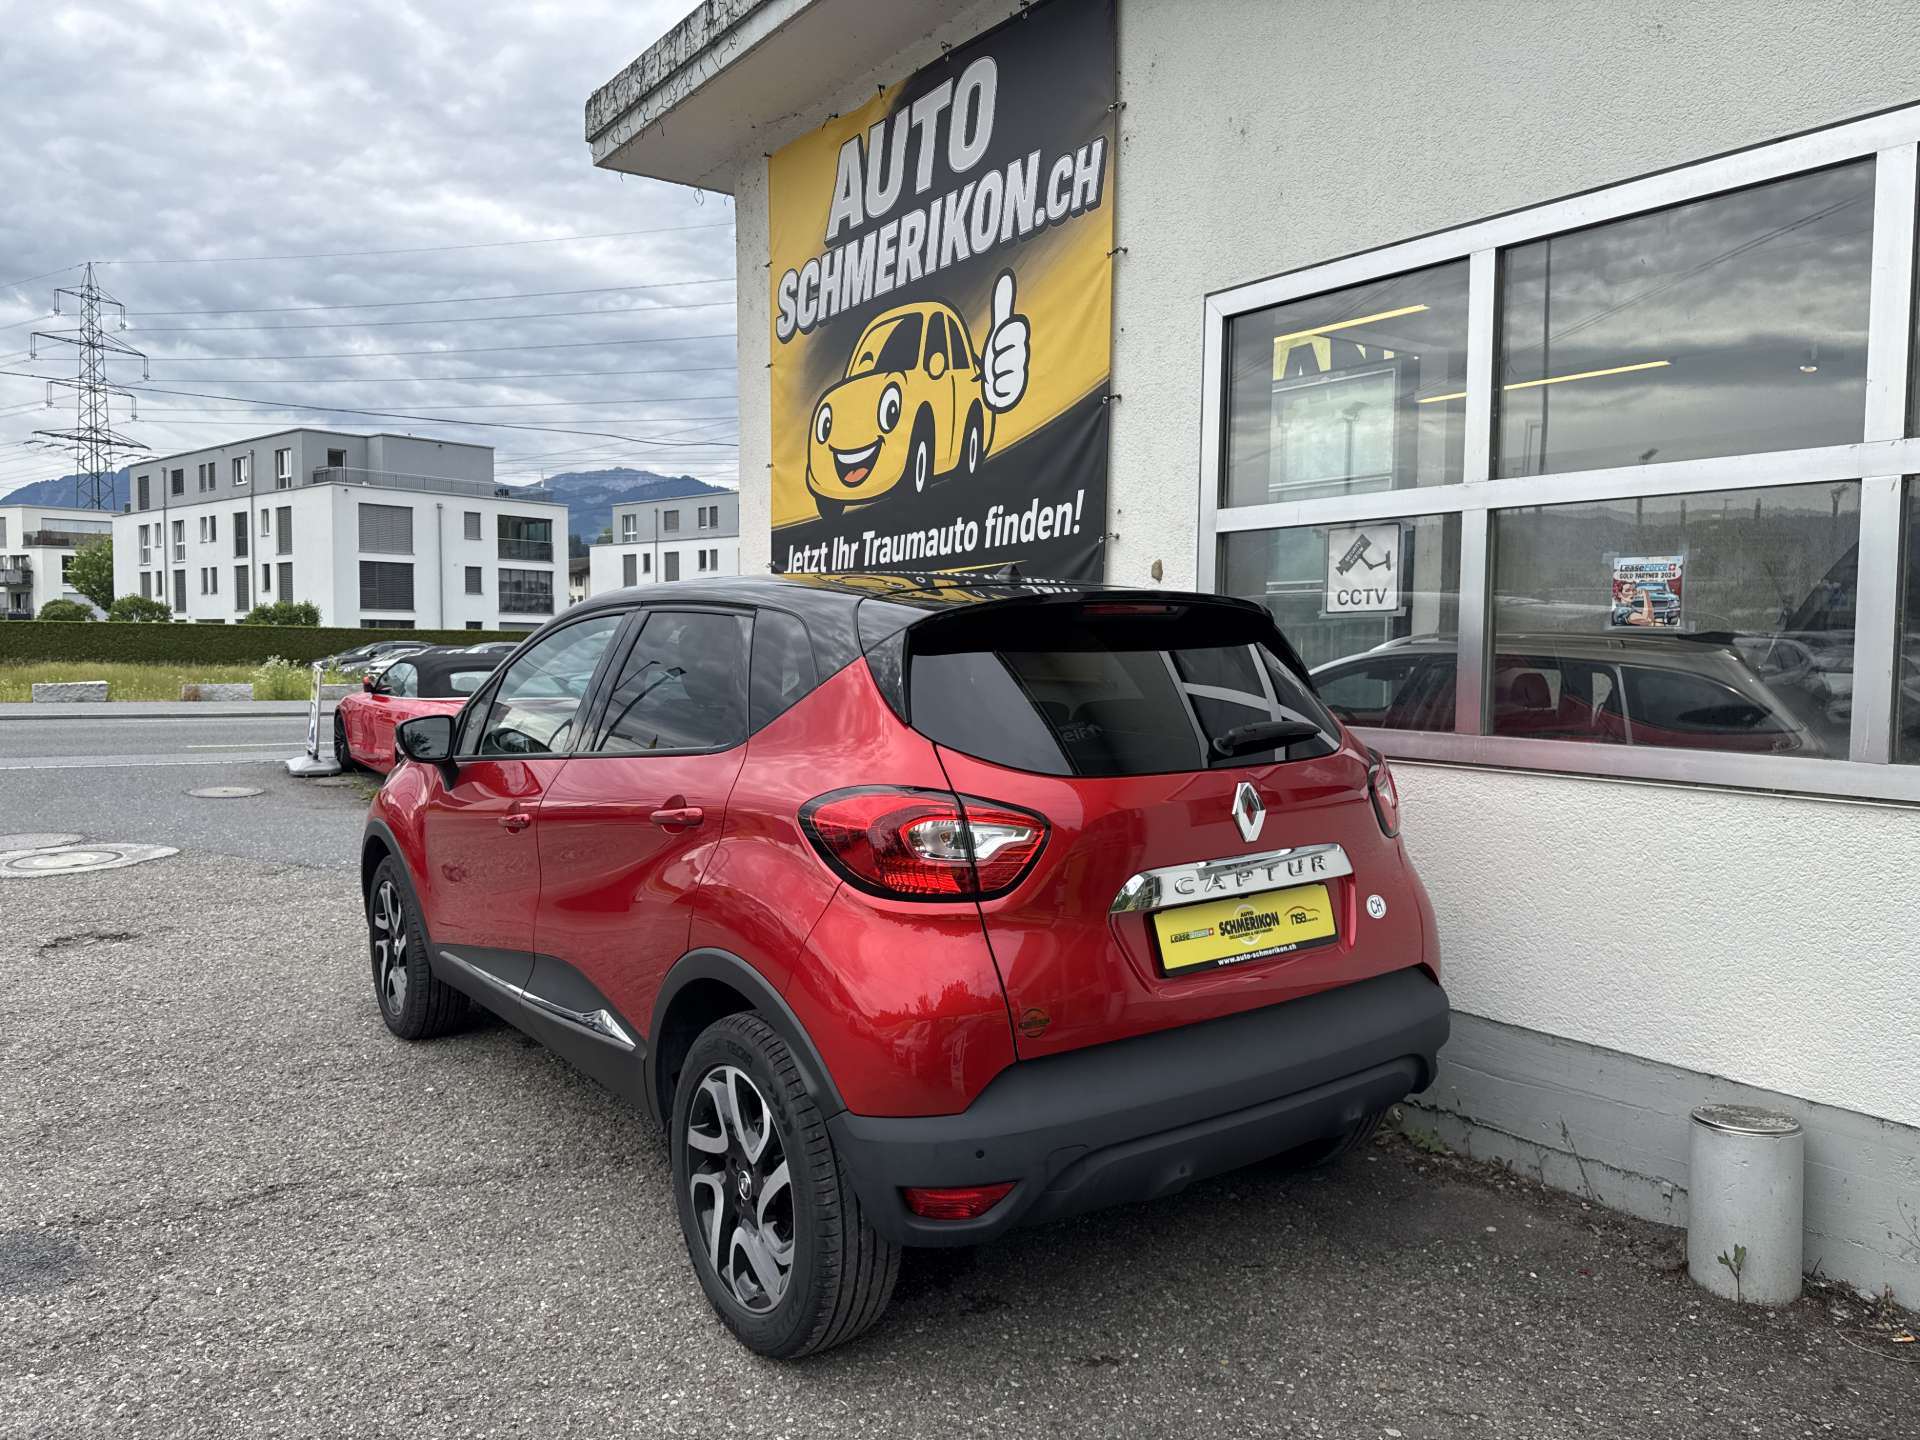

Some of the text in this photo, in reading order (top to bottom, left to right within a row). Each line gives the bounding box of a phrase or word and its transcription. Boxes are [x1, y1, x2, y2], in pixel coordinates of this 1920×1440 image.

[826, 56, 998, 243] AUTO
[776, 137, 1106, 339] SCHMERIKON.CH
[784, 489, 1085, 573] Jetzt Ihr Traumauto finden!
[1337, 587, 1388, 606] CCTV
[1174, 855, 1329, 895] CAPTUR
[1370, 898, 1383, 914] CH
[1218, 911, 1280, 936] SCHMERIKON
[1290, 912, 1307, 926] nsa
[1217, 943, 1297, 966] www.auto-schmerikon.ch
